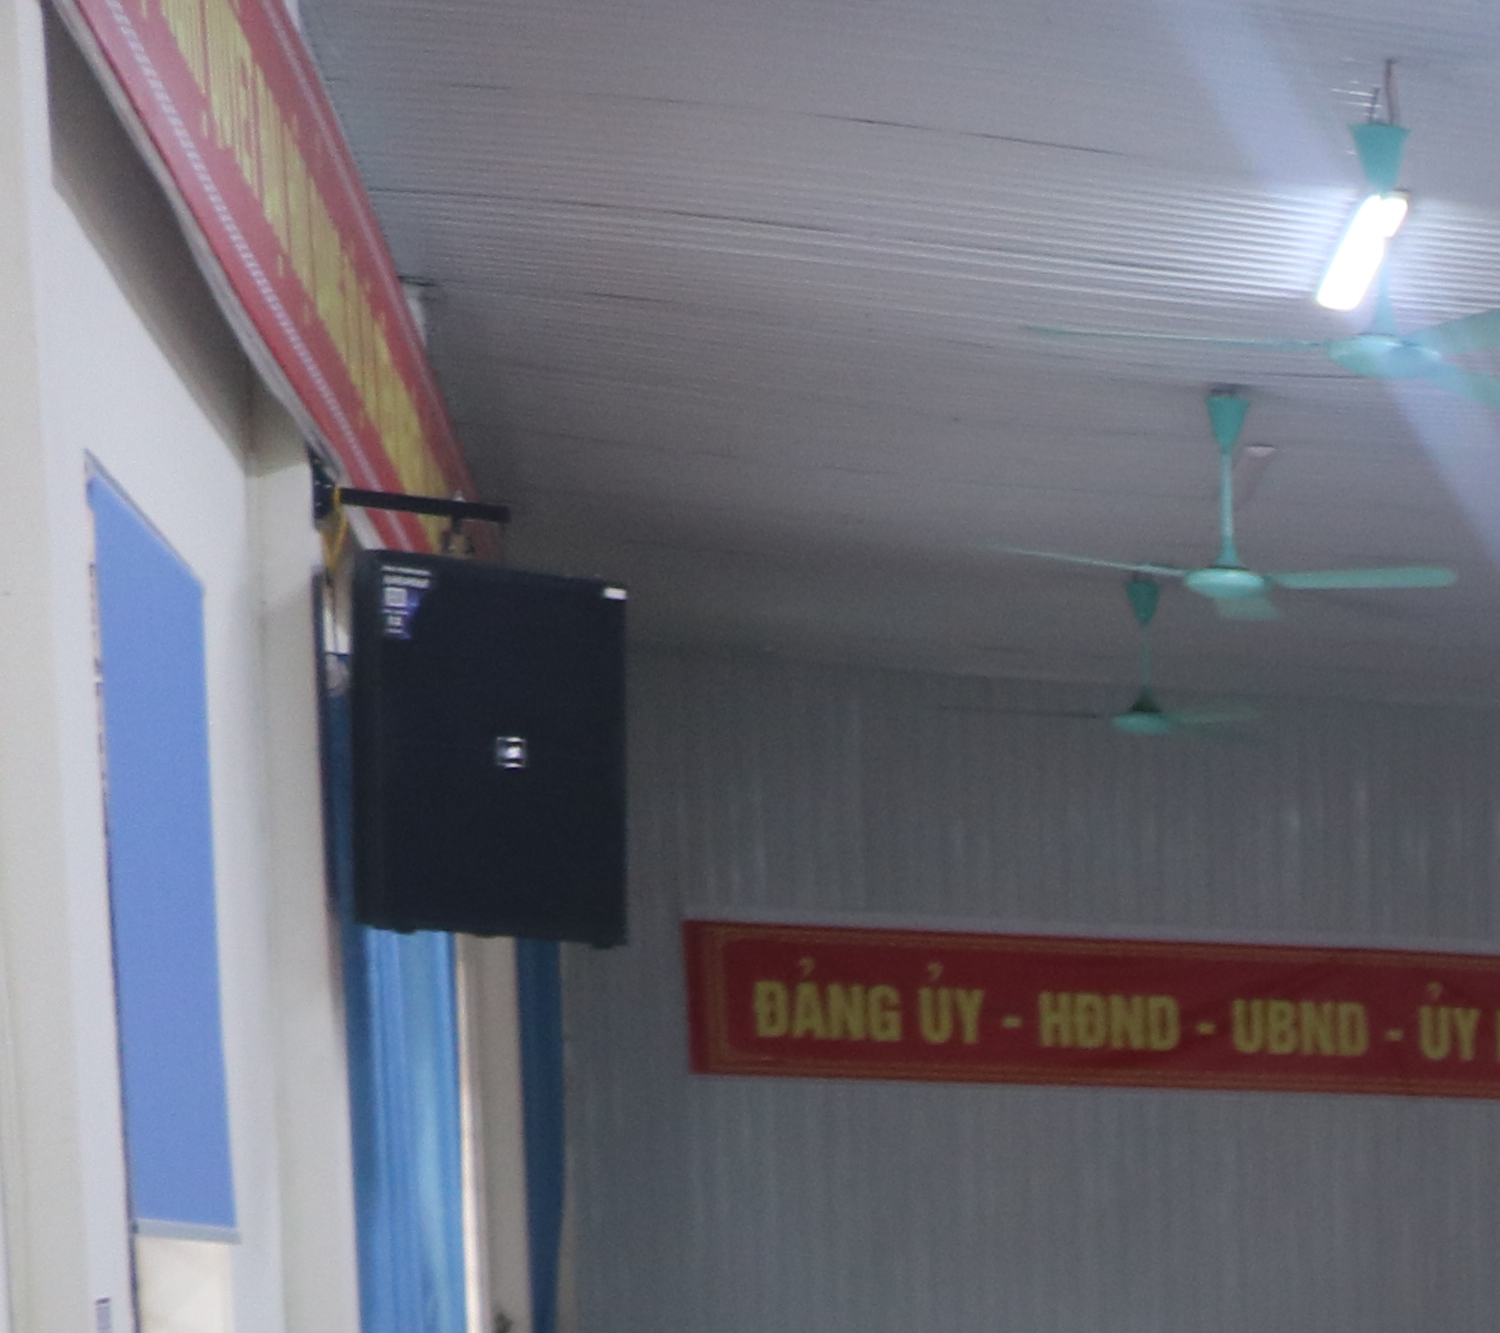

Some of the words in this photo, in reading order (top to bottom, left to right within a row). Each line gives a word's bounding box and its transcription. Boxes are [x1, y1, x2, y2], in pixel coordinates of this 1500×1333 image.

[752, 958, 902, 1042] ĐẢNG
[917, 962, 984, 1044] ỦY
[1037, 991, 1181, 1051] HĐND
[1231, 998, 1370, 1057] UBND
[1418, 982, 1481, 1060] ỦY
